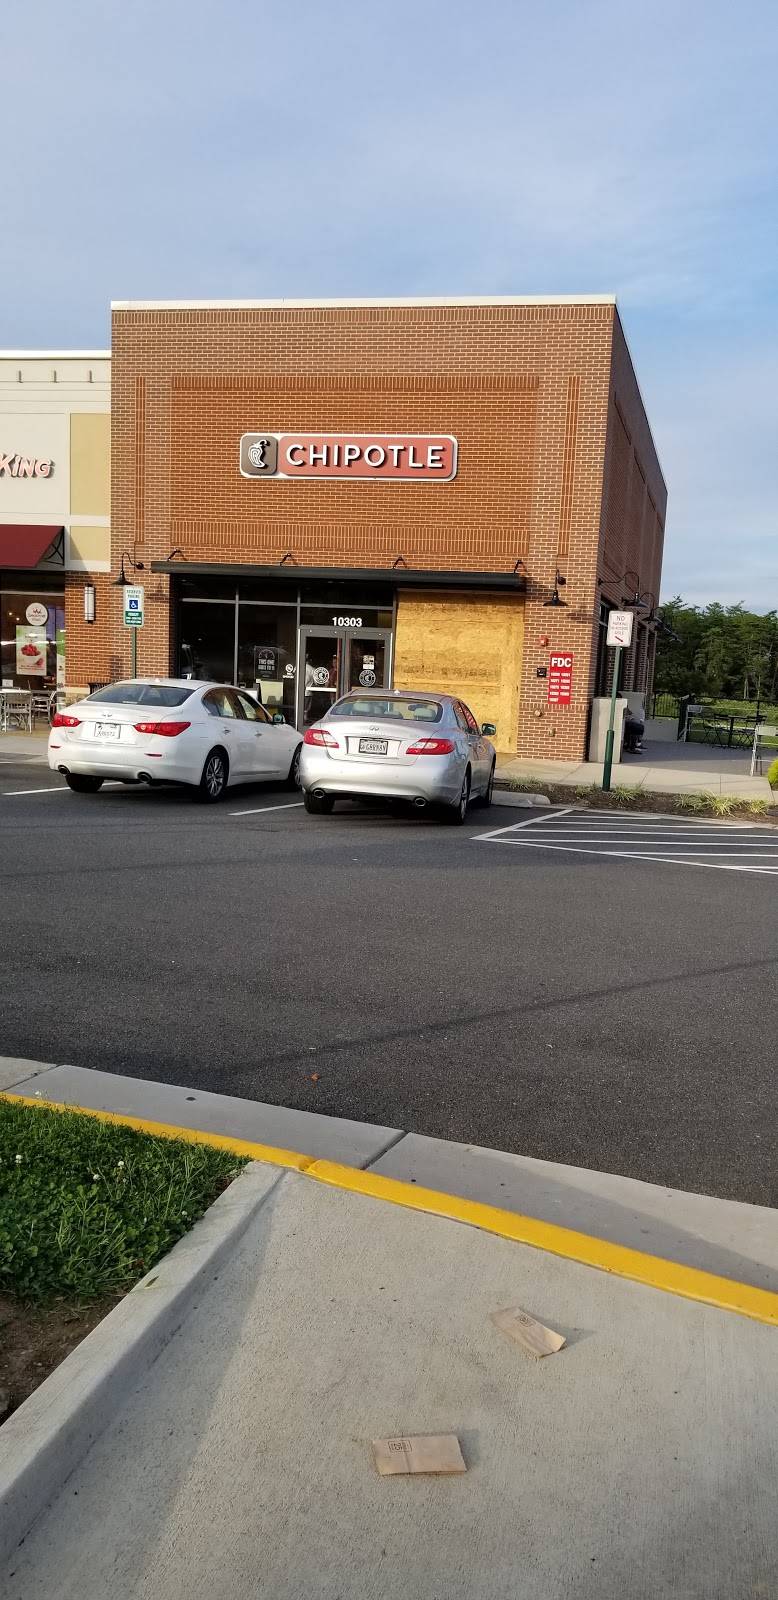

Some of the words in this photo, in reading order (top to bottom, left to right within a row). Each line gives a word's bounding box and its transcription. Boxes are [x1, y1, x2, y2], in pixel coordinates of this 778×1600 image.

[285, 443, 445, 468] CHIPOTLE
[332, 616, 363, 627] 10303
[551, 657, 572, 668] FDC
